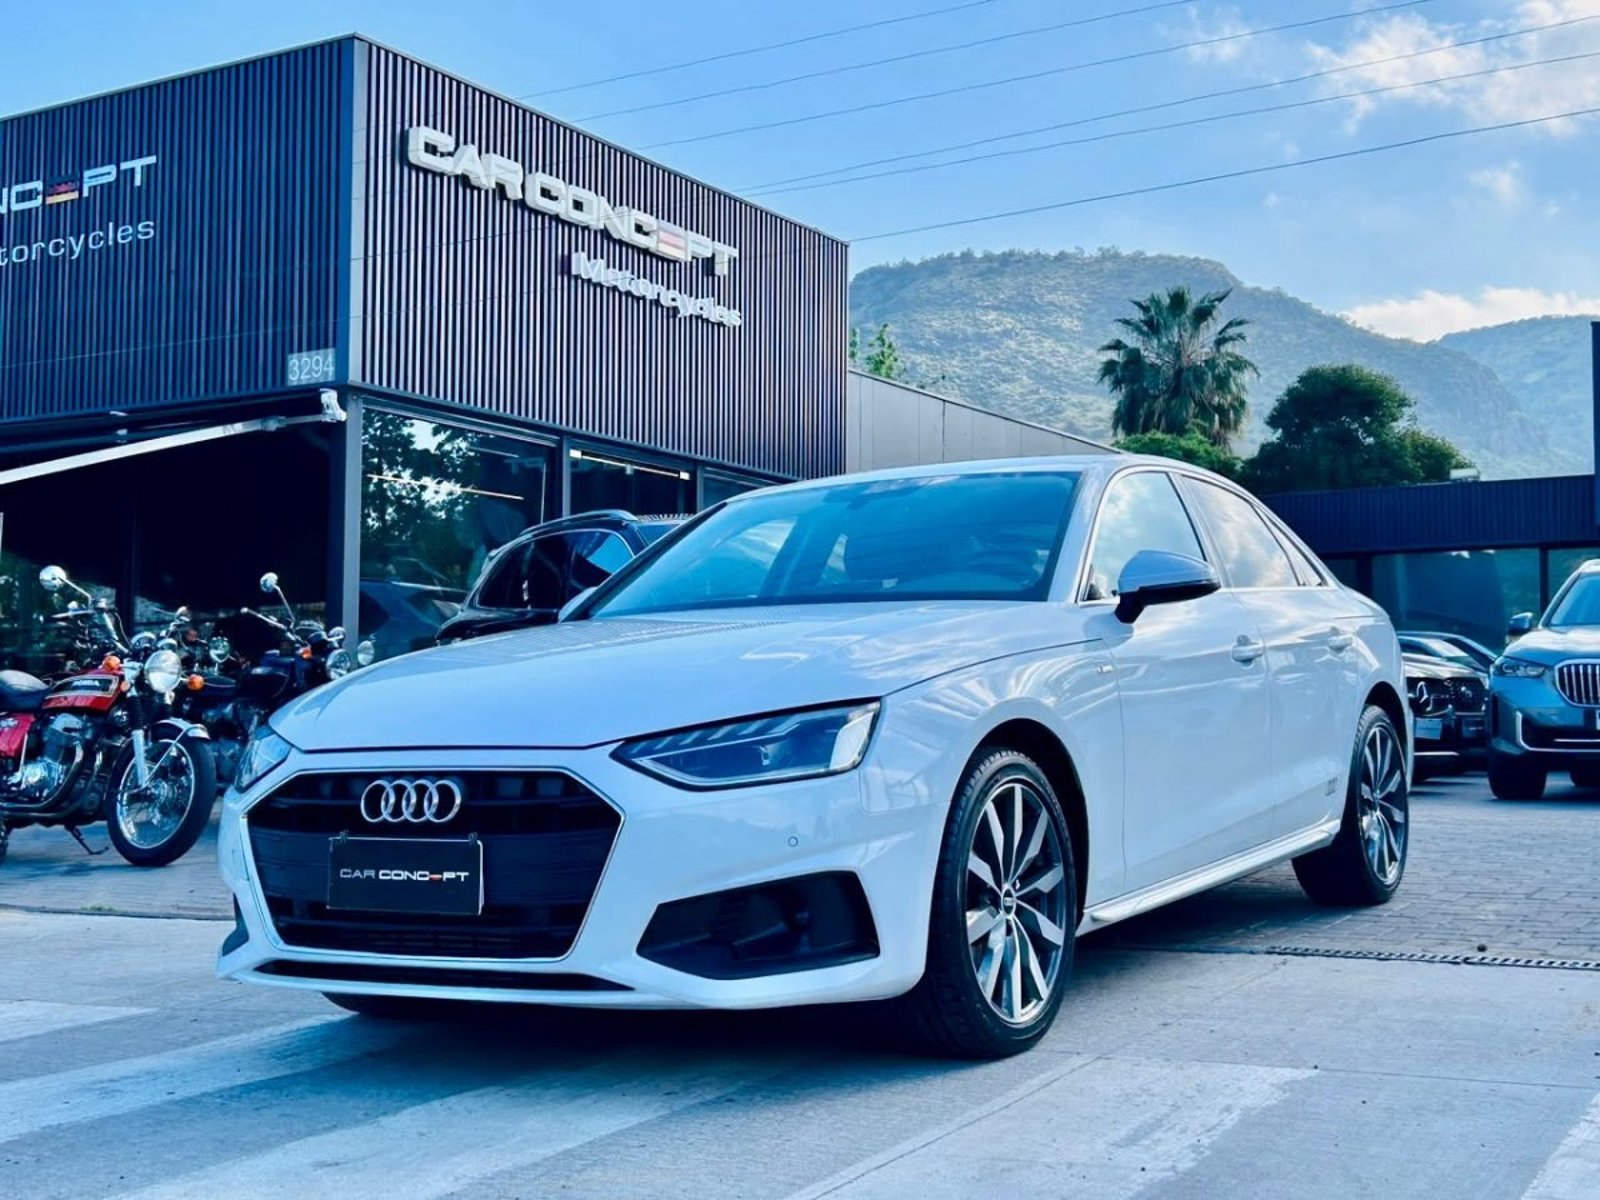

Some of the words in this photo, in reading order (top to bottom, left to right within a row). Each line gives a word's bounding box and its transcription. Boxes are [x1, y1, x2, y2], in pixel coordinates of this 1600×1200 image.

[408, 125, 523, 200] CAR
[572, 251, 741, 326] Motorcycles
[289, 351, 334, 380] 3294
[339, 868, 375, 879] CAR
